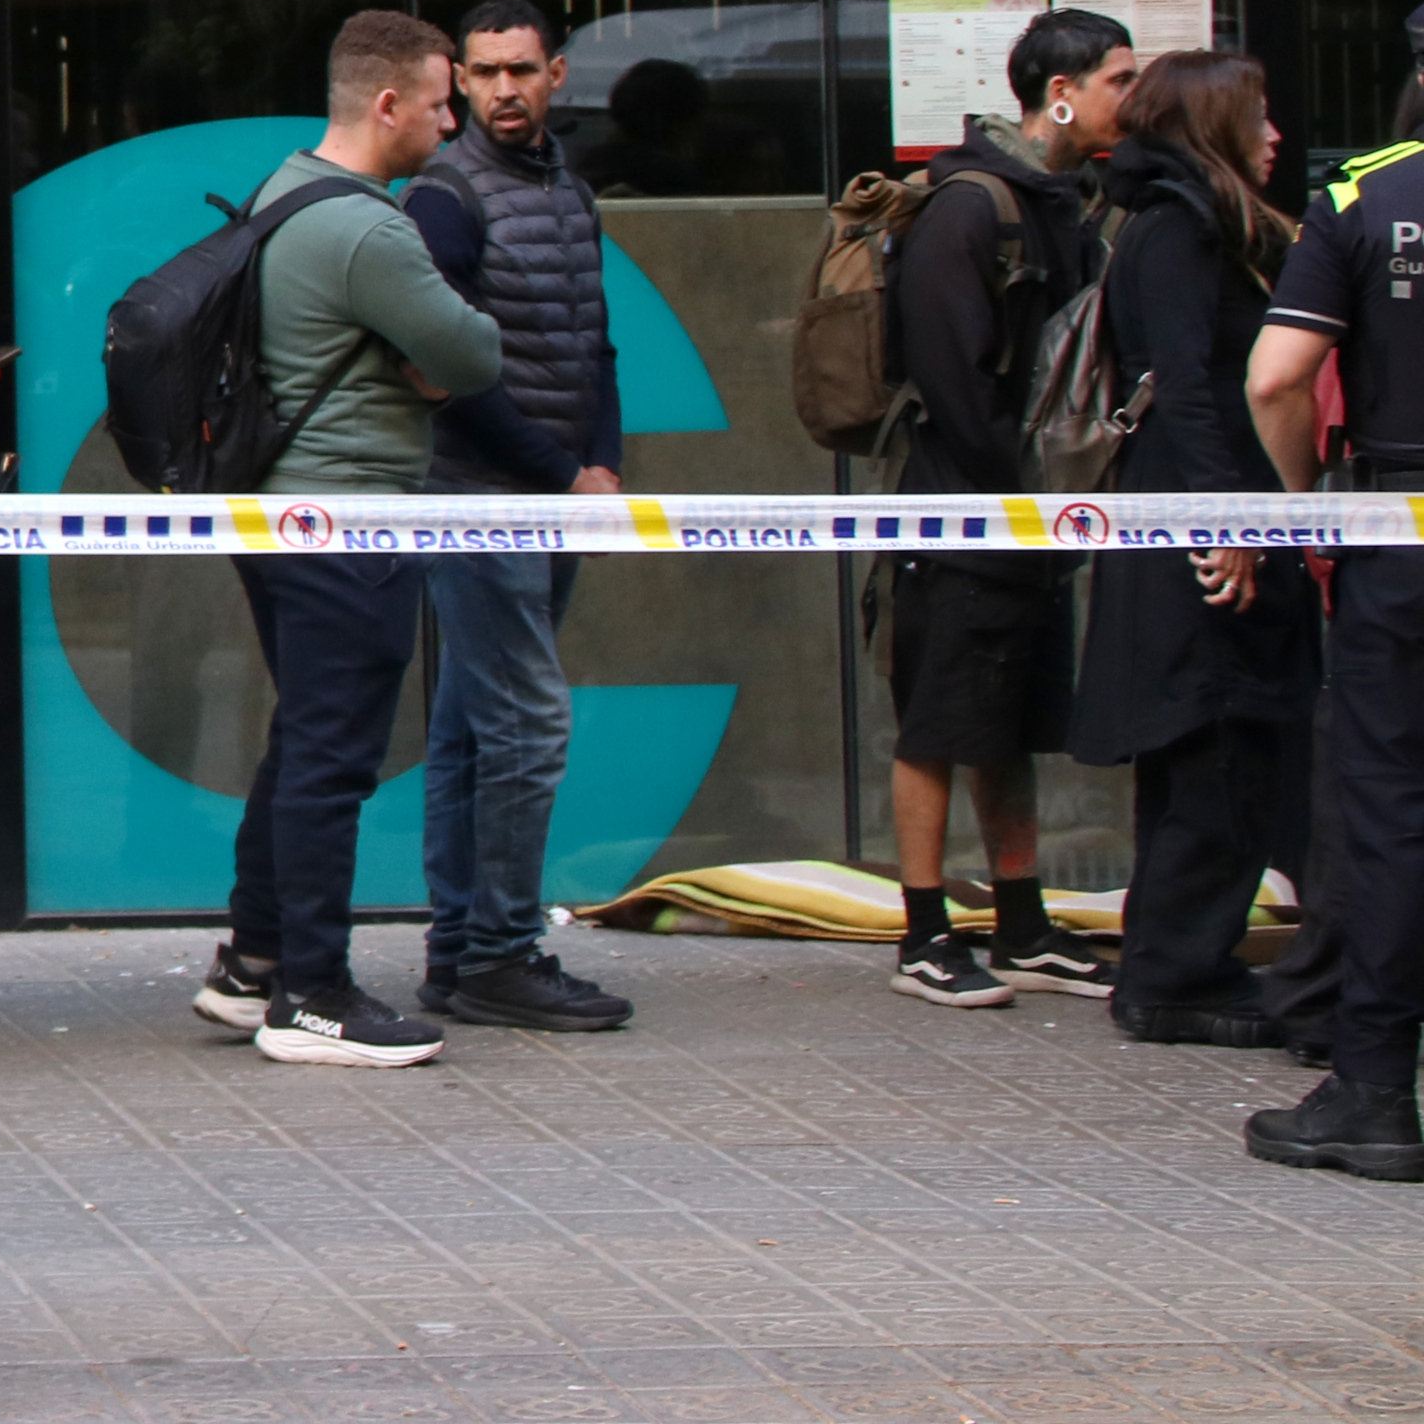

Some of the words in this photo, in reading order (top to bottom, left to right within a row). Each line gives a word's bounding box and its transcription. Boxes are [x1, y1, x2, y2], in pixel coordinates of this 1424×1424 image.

[64, 539, 141, 551] Guàrdia
[147, 540, 217, 551] Urbana
[342, 529, 399, 550] NO
[412, 529, 565, 550] PASSEU
[681, 528, 820, 548] POLICIA
[292, 1009, 344, 1039] HOKA
